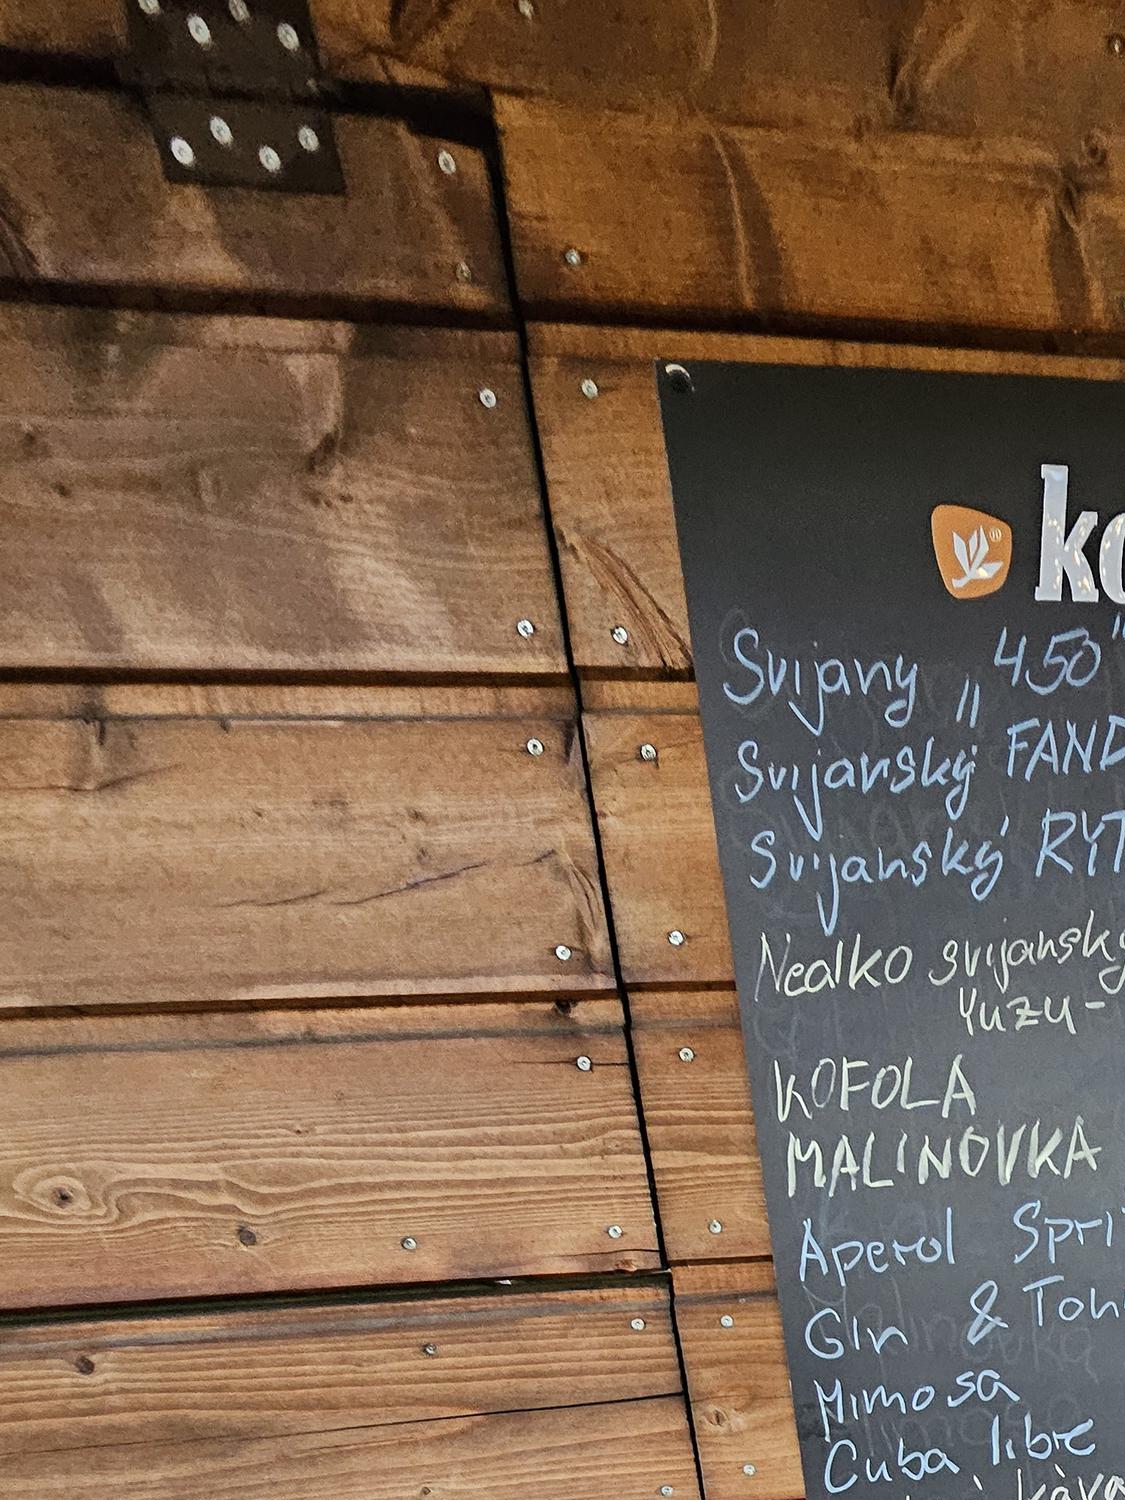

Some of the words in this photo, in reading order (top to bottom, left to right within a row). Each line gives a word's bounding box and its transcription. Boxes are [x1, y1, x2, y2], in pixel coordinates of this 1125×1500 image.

[723, 626, 918, 737] Svijany
[734, 736, 979, 842] Svijanský
[750, 813, 1010, 937] Svijanský
[754, 931, 914, 1004] Nealko
[772, 1053, 978, 1124] KOFOLA
[786, 1114, 1102, 1200] MALINOVKA
[799, 1206, 956, 1284] Aperol
[803, 1308, 909, 1361] Gin
[966, 1279, 1010, 1347] &
[812, 1366, 1022, 1444] Mimosa
[822, 1436, 961, 1496] Cuba
[989, 1415, 1099, 1469] libre
